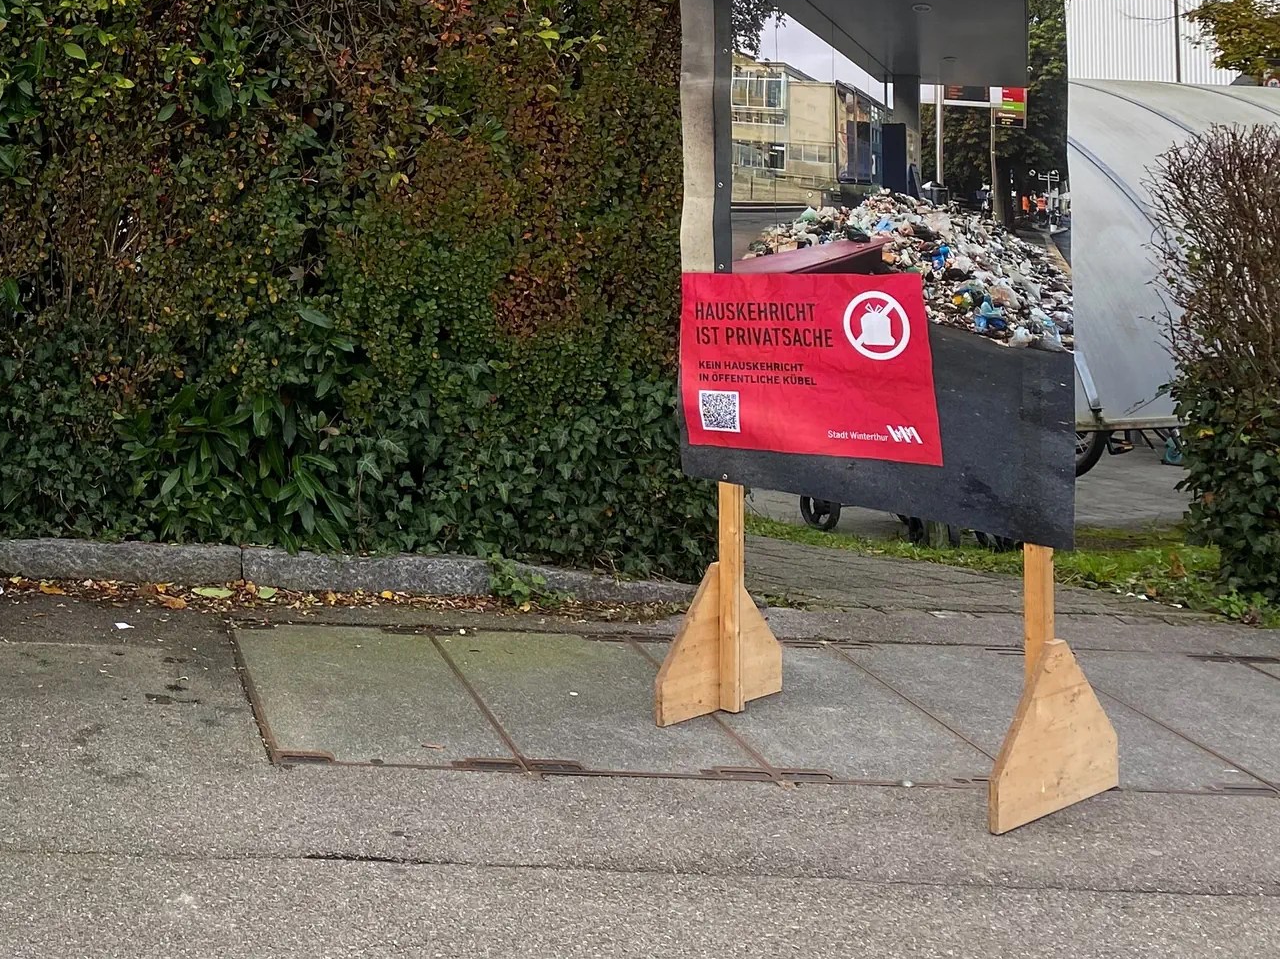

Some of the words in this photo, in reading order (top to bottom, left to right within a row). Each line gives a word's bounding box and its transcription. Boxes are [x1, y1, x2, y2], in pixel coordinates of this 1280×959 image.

[695, 302, 815, 321] HAUSKEHRICHT
[696, 327, 719, 345] IST
[725, 327, 833, 348] PRIVATSACHE
[699, 361, 720, 369] KEIN
[724, 361, 804, 372] HAUSKEHRICHT
[712, 372, 780, 384] ÖFFENTLICHE
[783, 374, 817, 386] KÜBEL
[828, 430, 849, 439] Stadt
[850, 432, 888, 441] Winterthur
